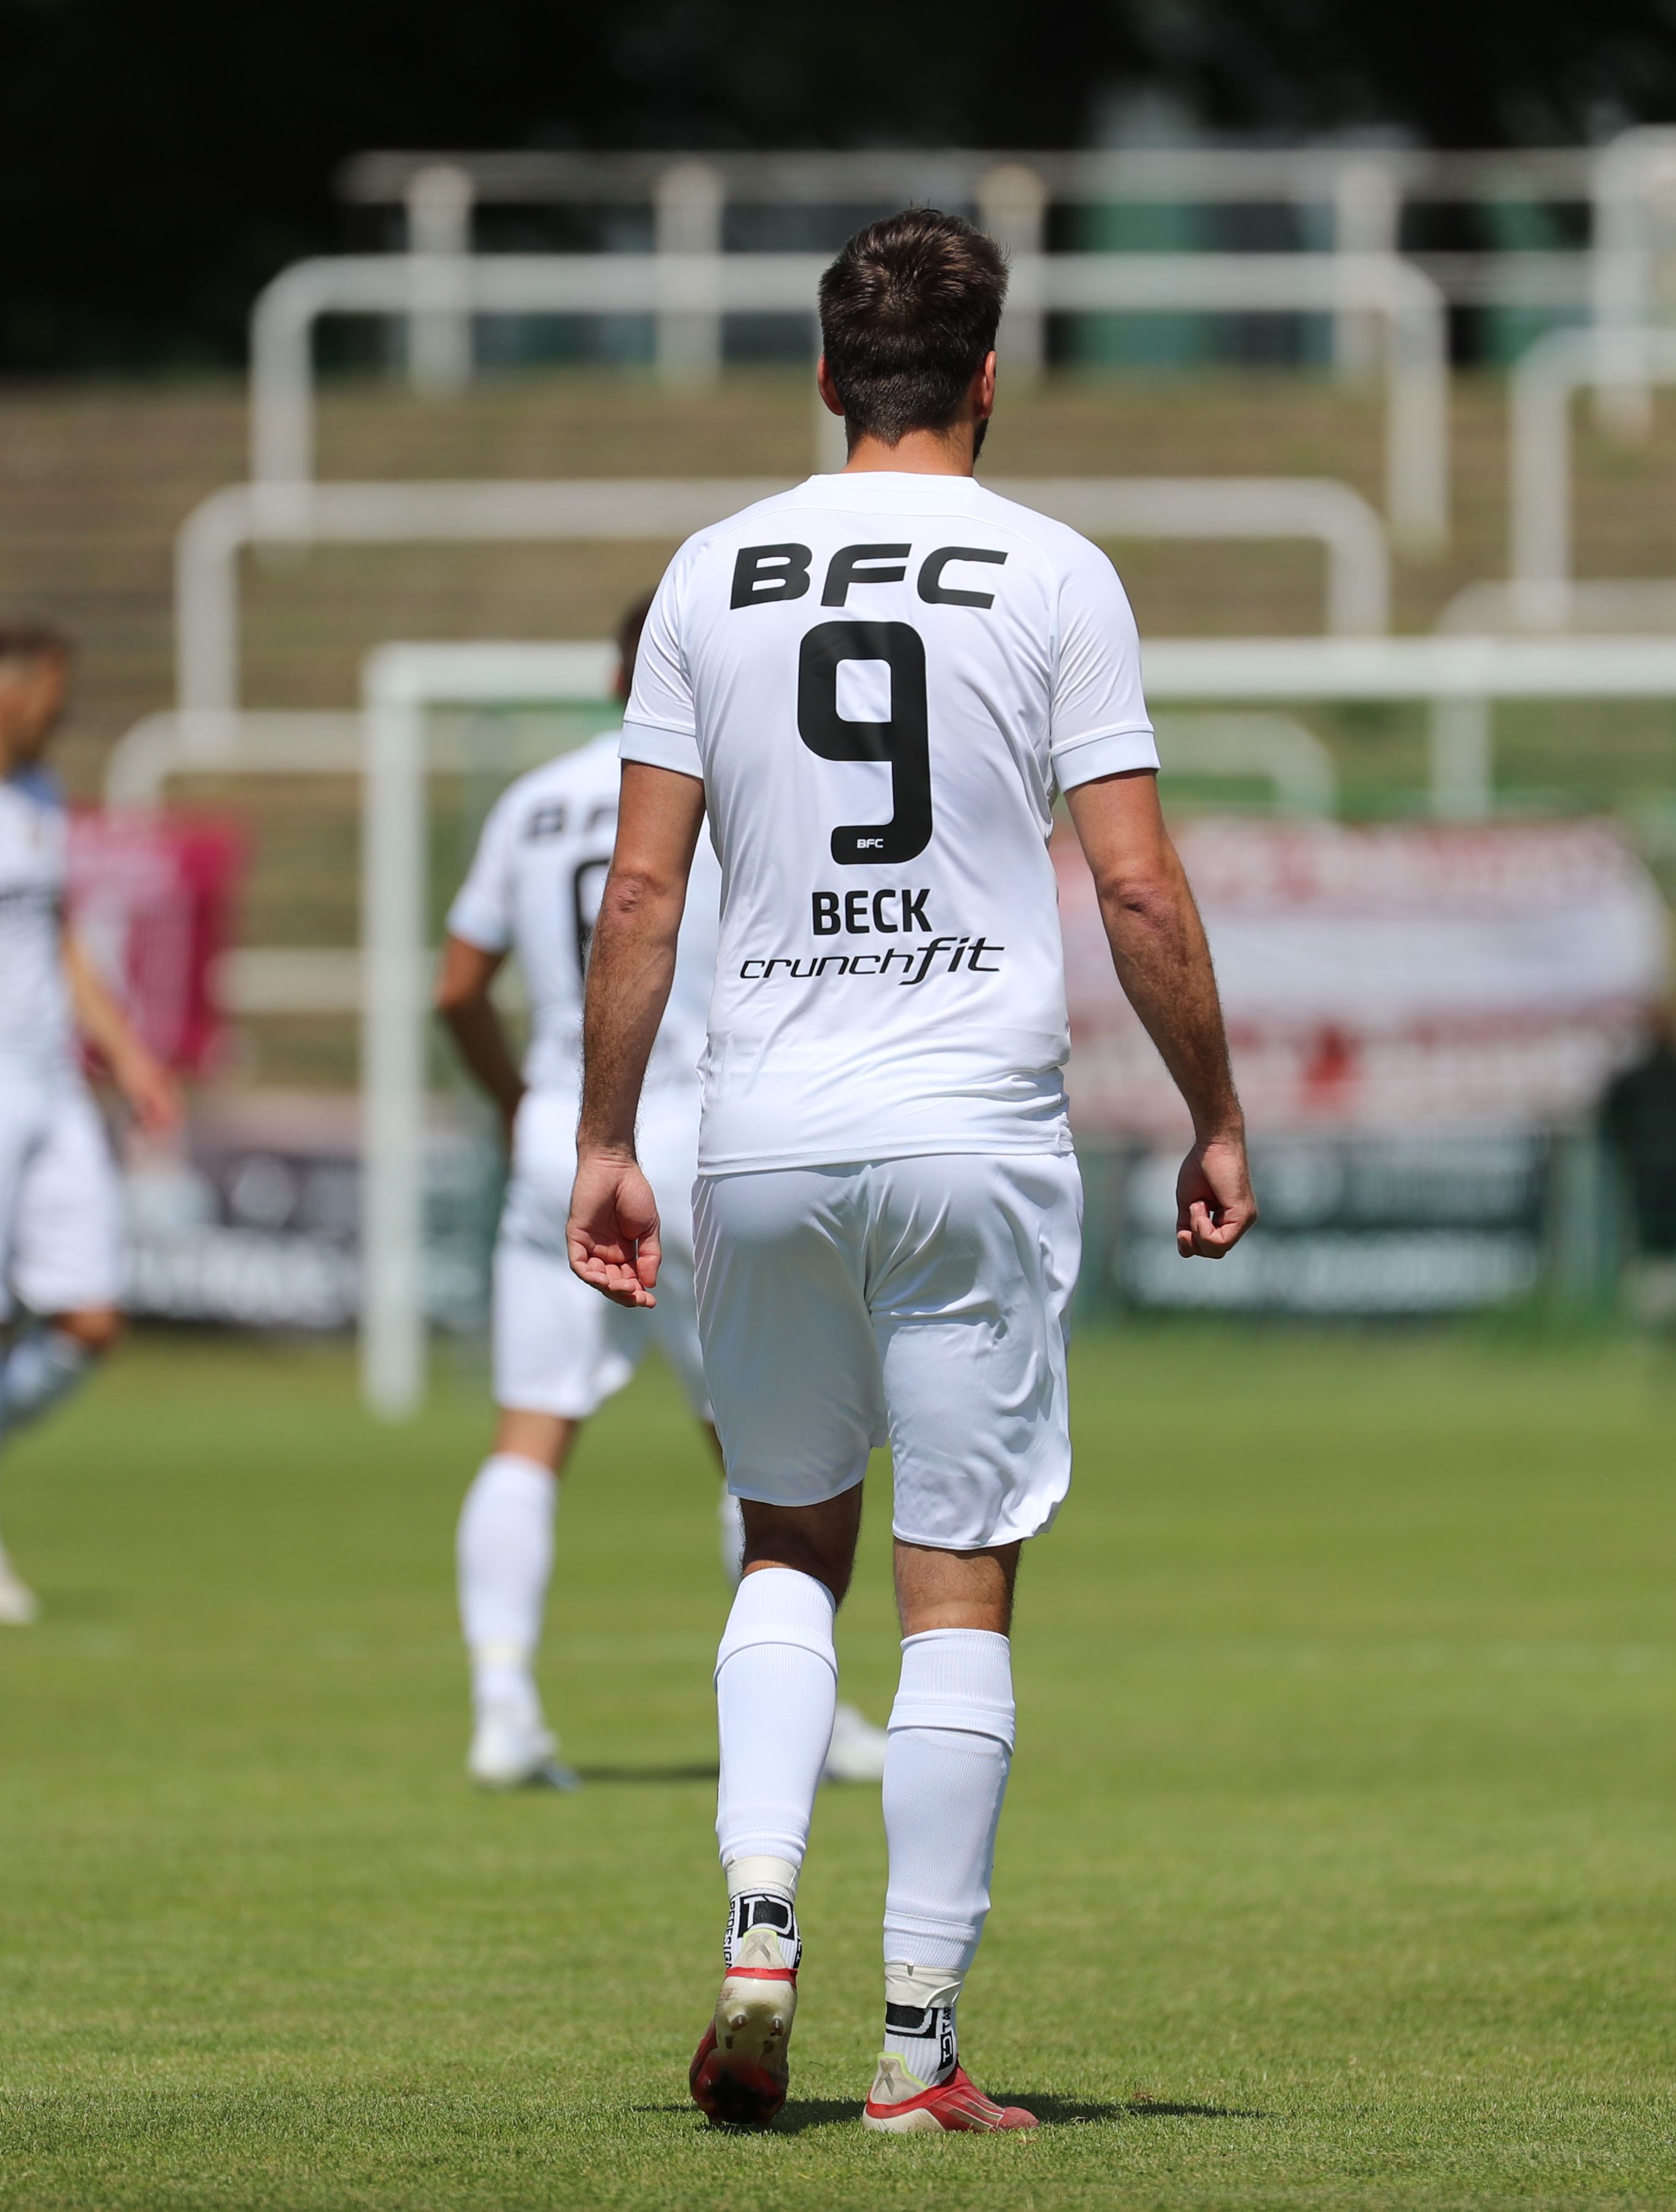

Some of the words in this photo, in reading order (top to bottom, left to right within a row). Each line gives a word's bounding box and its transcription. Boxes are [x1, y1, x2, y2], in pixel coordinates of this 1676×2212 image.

[730, 543, 1008, 609] BFC
[797, 621, 933, 865] 9
[856, 838, 884, 849] BFC
[812, 888, 933, 935] BECK
[739, 937, 1005, 986] crunchfit
